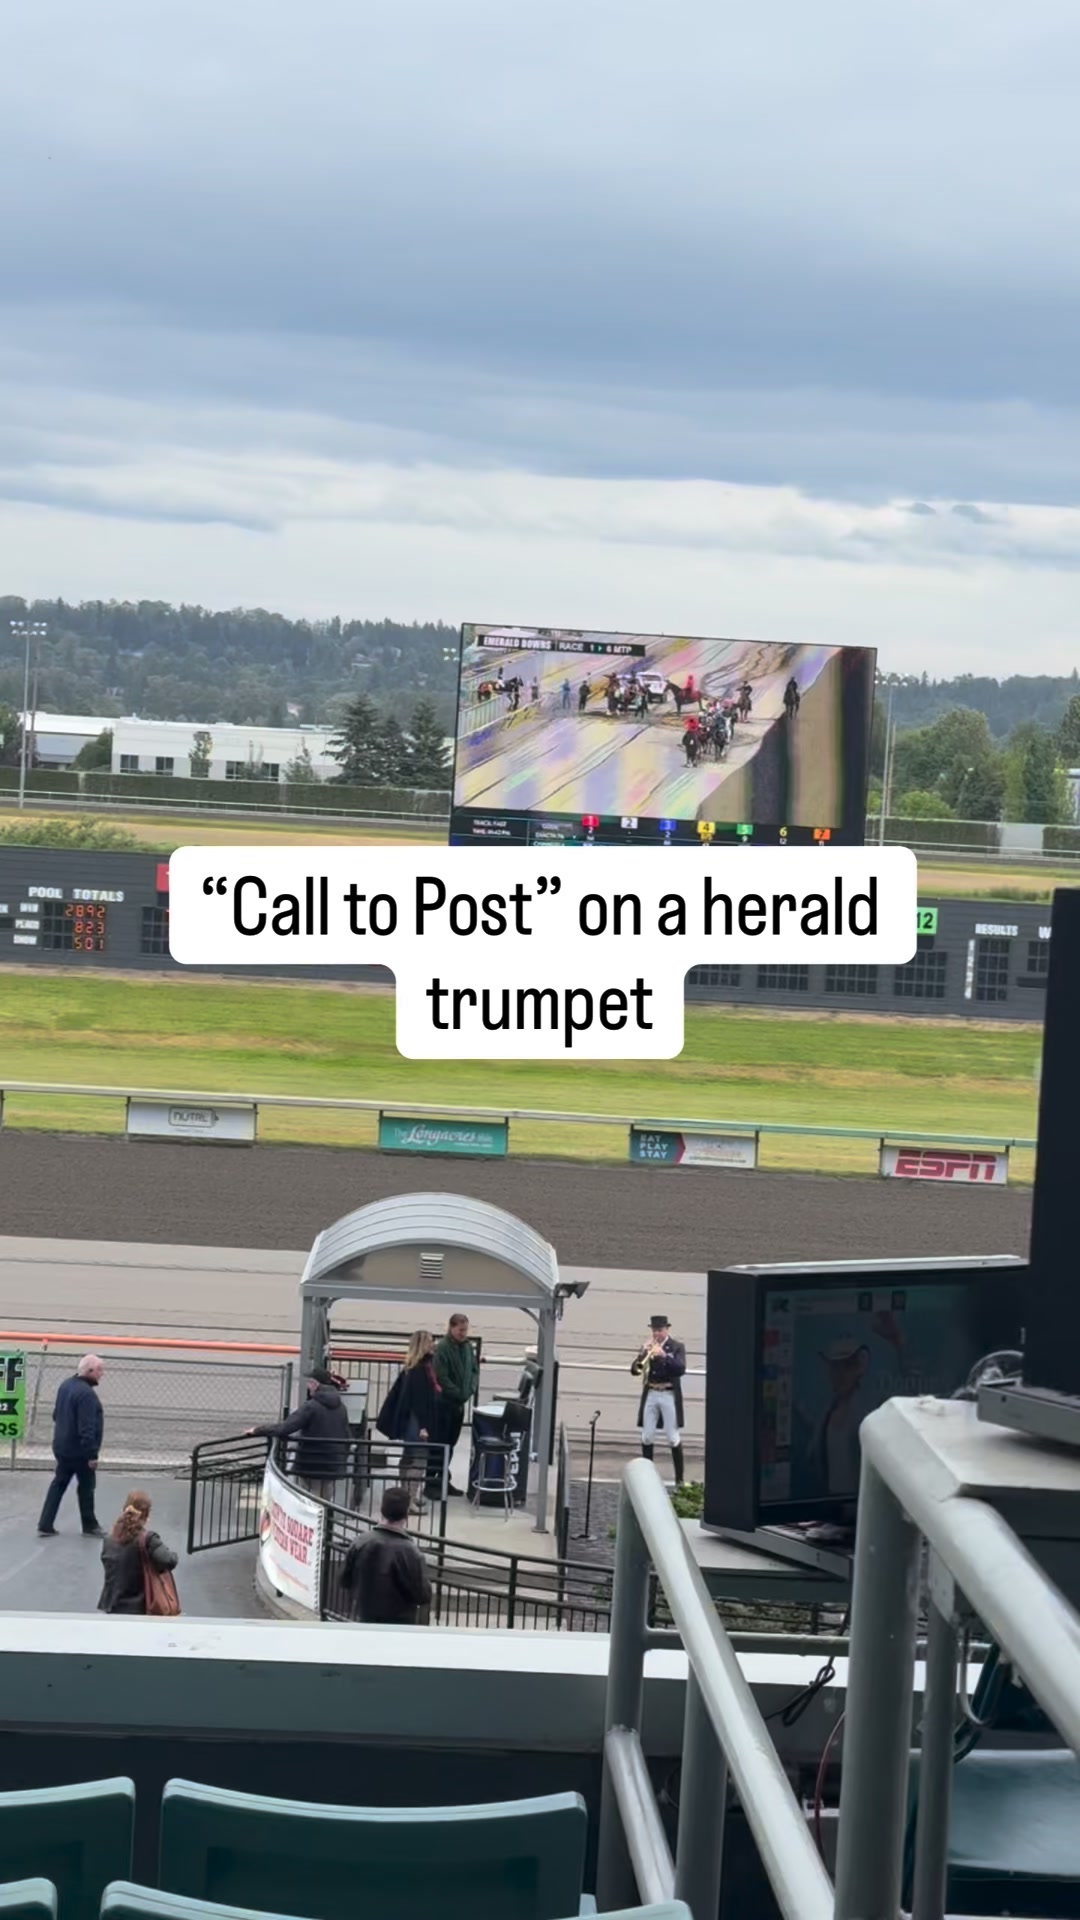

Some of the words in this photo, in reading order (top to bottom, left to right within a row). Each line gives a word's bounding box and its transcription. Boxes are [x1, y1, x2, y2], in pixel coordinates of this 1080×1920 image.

[483, 636, 519, 648] EMERALD
[559, 642, 584, 651] RACE
[613, 646, 632, 654] MTP
[779, 827, 787, 837] 6
[28, 886, 63, 899] POOL
[73, 888, 125, 902] TOTALS
[65, 904, 105, 918] 2892
[75, 921, 105, 935] 823
[975, 923, 1019, 936] RESULTS
[74, 937, 104, 950] 501
[401, 1123, 476, 1146] Longacres
[640, 1134, 661, 1142] EAT
[640, 1150, 668, 1159] STAY
[895, 1149, 996, 1181] ESPN
